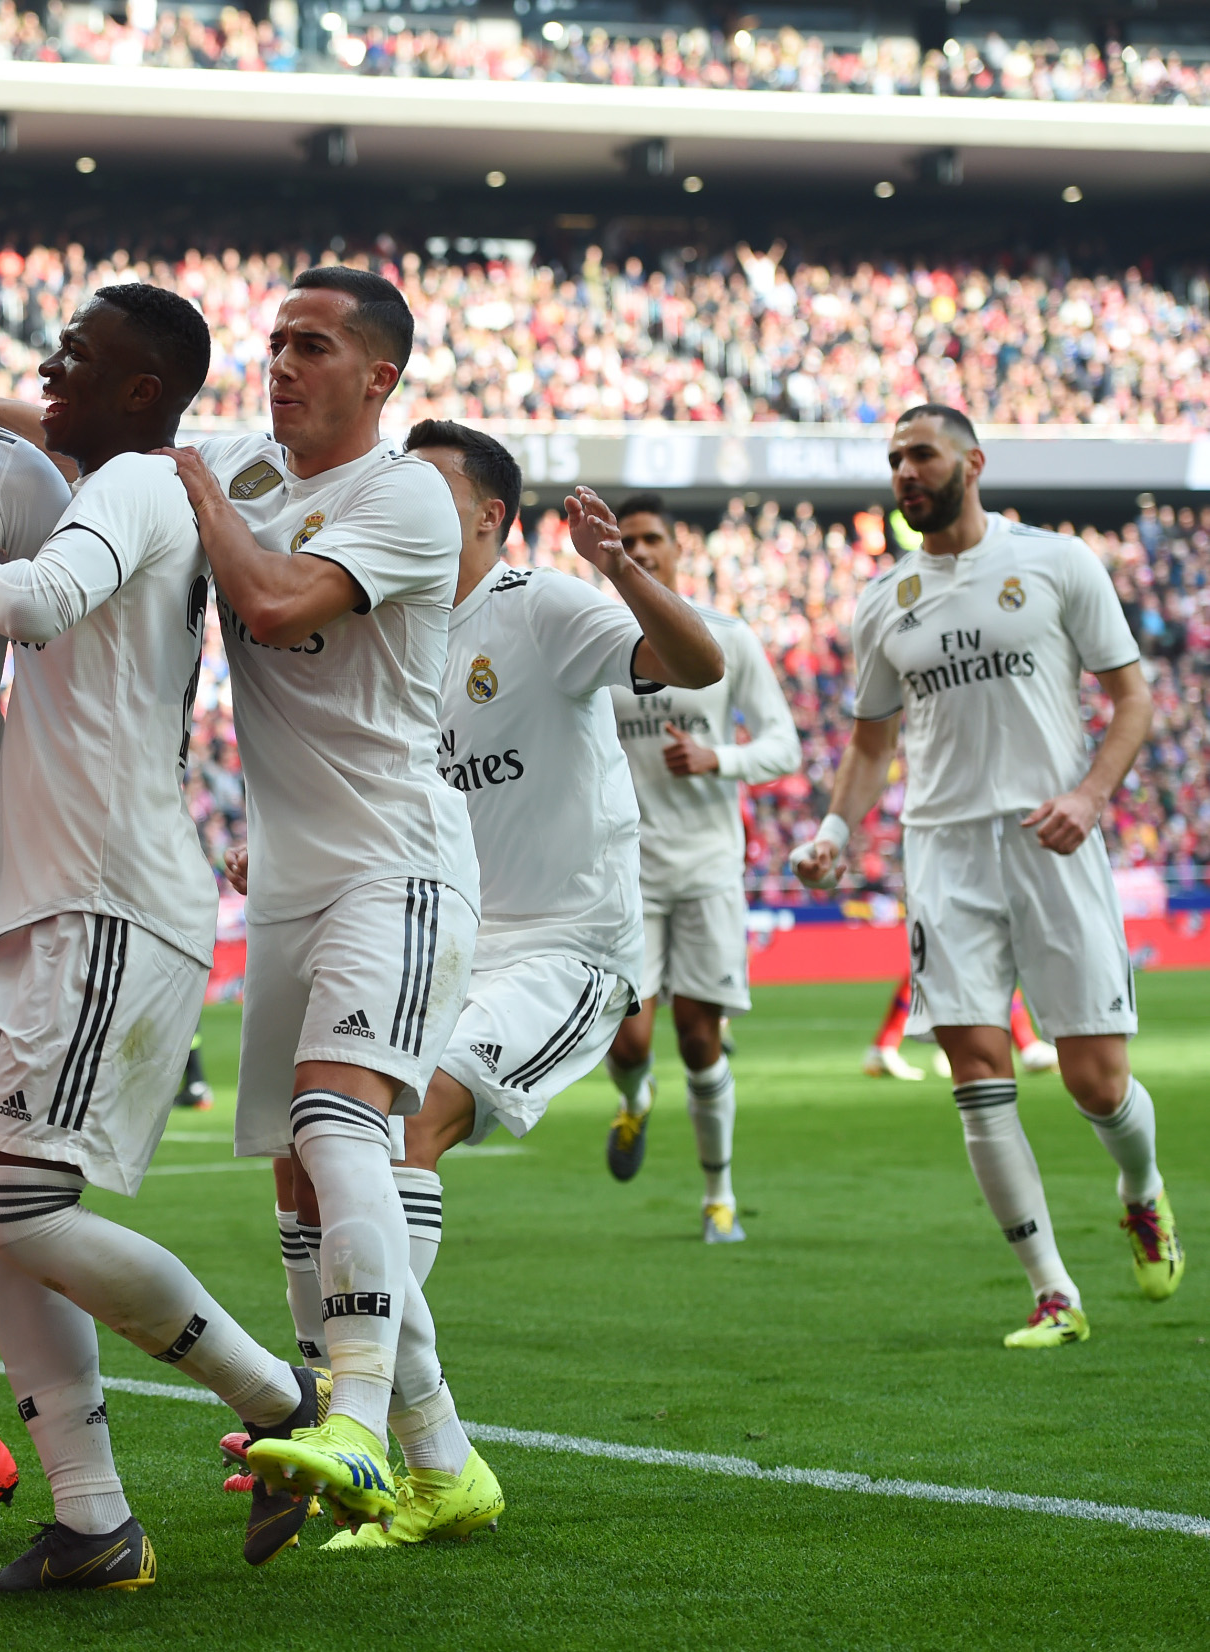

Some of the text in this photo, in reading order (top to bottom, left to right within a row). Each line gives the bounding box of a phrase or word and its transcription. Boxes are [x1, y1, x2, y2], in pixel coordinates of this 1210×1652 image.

[941, 629, 981, 654] Fly
[904, 649, 1035, 701] Emirates
[638, 694, 672, 712] Fly
[439, 749, 524, 792] rates
[911, 921, 926, 974] 9
[332, 1024, 376, 1040] adidas
[469, 1044, 498, 1075] adidas
